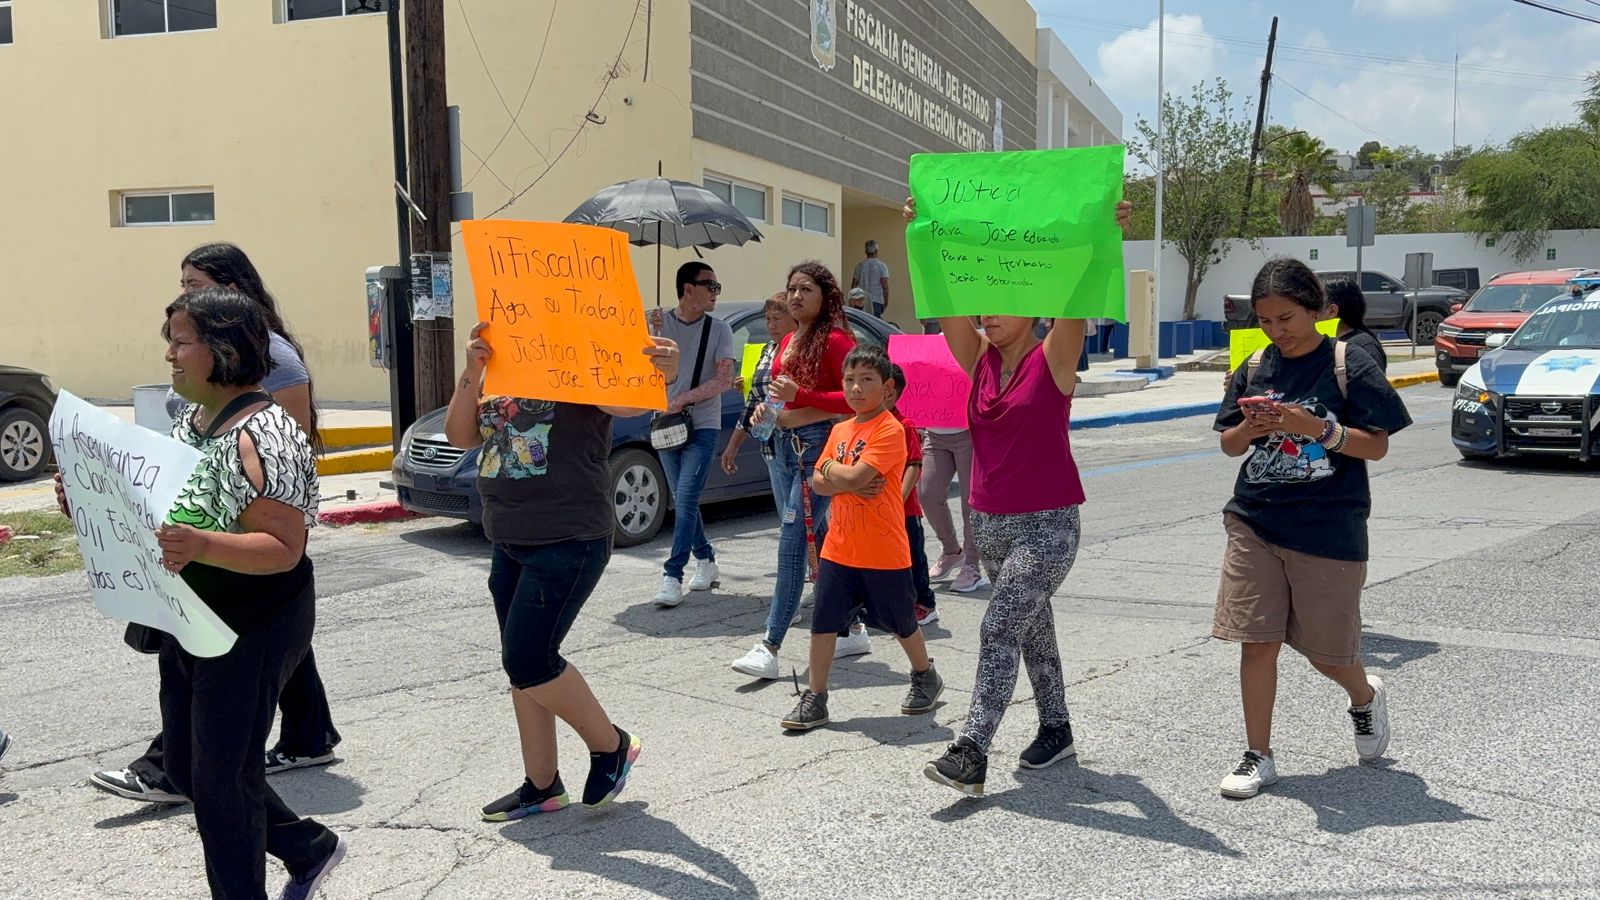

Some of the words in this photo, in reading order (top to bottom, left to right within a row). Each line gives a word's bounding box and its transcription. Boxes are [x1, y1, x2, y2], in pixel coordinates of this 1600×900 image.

[846, 0, 899, 64] FISCALIA
[901, 39, 944, 94] GENERAL
[945, 70, 961, 104] DEL
[962, 83, 990, 123] ESTADO
[853, 54, 921, 122] DELEGACIÓN
[923, 98, 956, 140] REGIÓN
[957, 119, 986, 152] CENTRO
[489, 288, 533, 326] Aga
[544, 297, 560, 314] su
